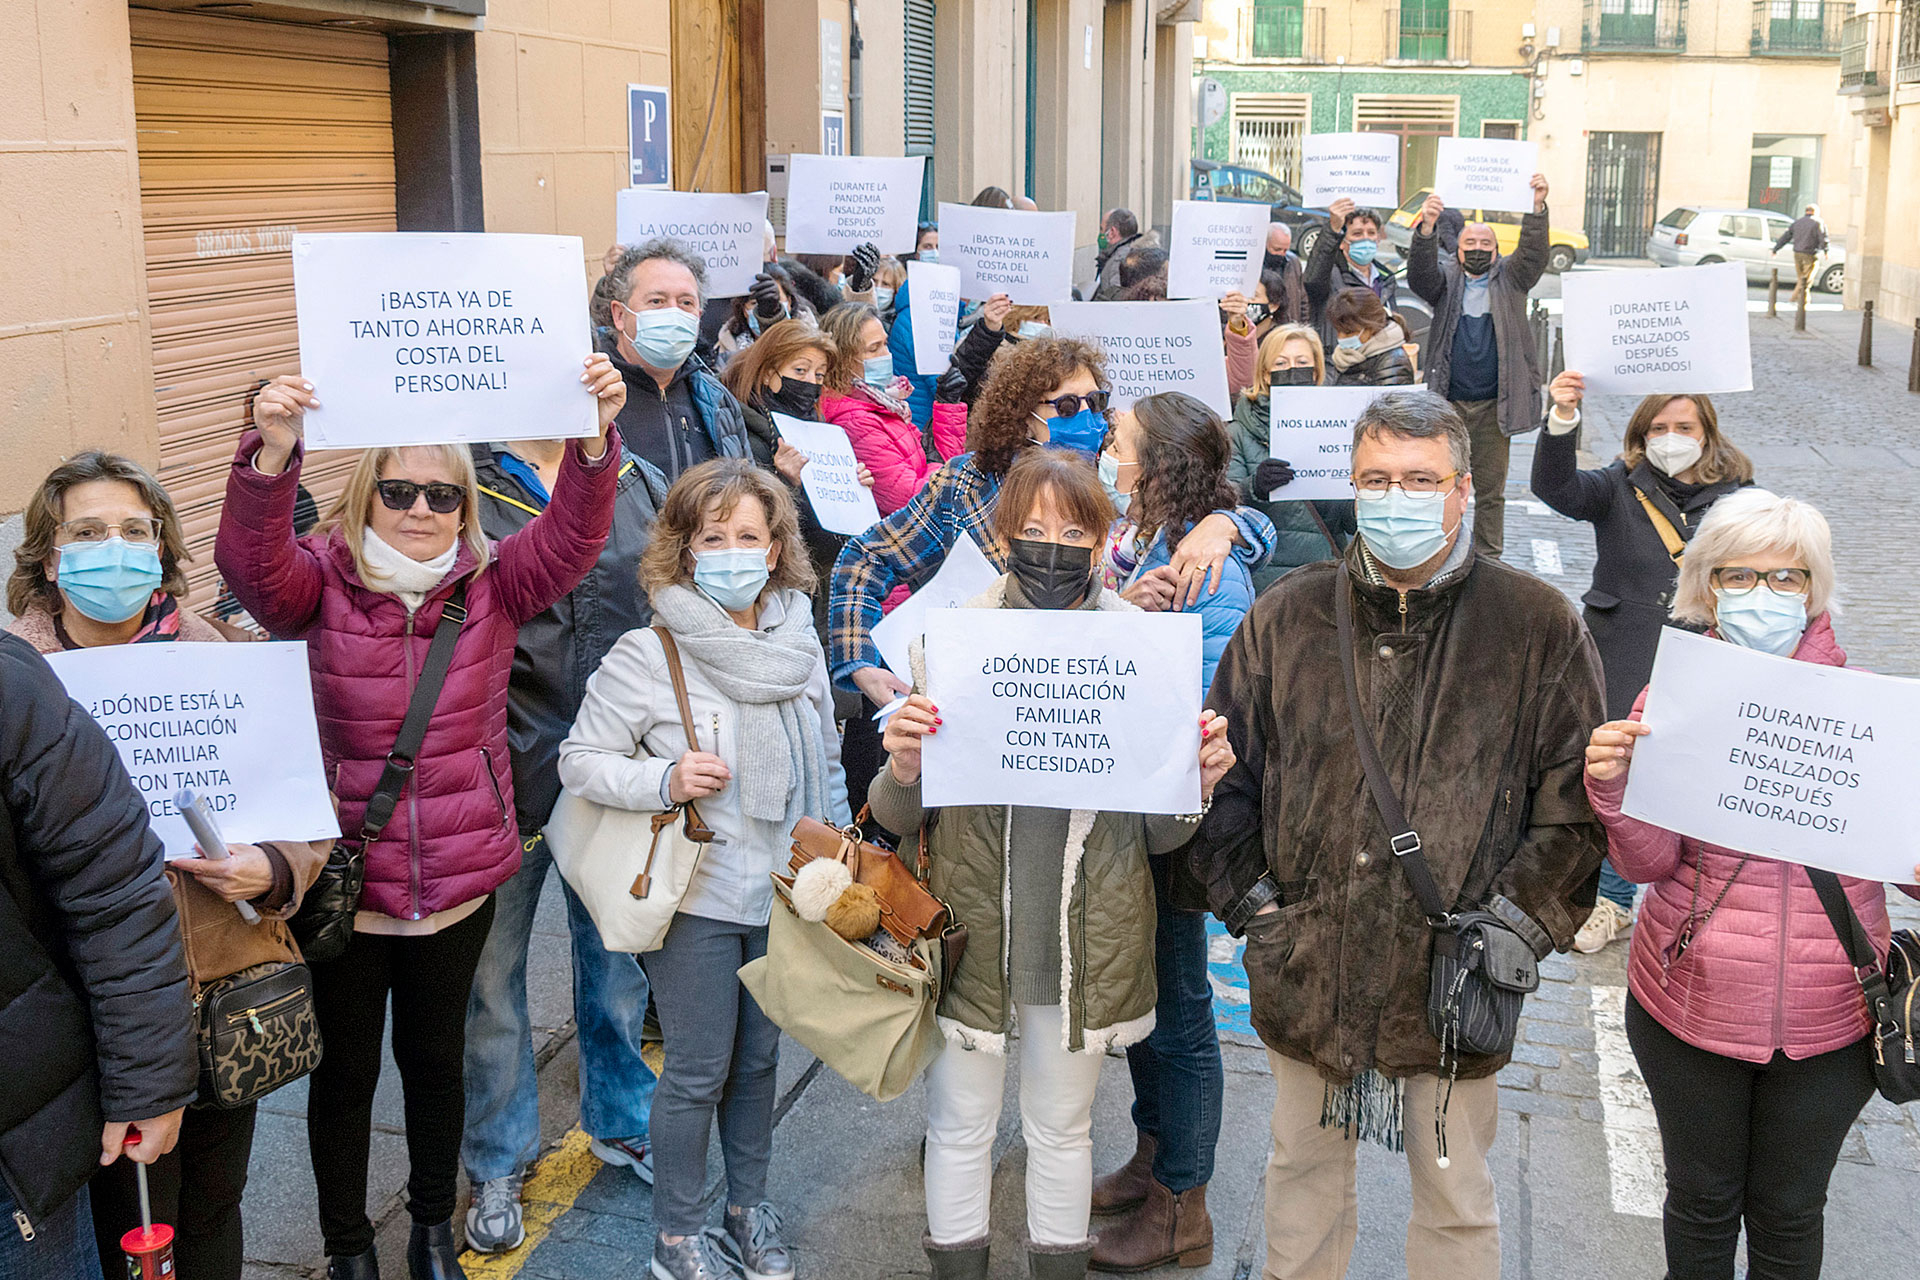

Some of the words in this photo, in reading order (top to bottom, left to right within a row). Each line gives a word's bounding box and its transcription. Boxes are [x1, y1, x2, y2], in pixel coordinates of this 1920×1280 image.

[643, 99, 656, 142] P
[830, 182, 875, 191] ¡DURANTE
[877, 182, 888, 191] LA
[835, 194, 881, 203] PANDEMIA
[829, 205, 885, 215] ENSALZADOS
[640, 223, 656, 236] LA
[659, 220, 729, 236] VOCACIÓN
[734, 221, 753, 234] NO
[837, 217, 876, 227] DESPUÉS
[1208, 224, 1243, 235] GERENCIA
[827, 228, 884, 238] IGNORADOS!
[972, 234, 1006, 245] ¡BASTA
[1008, 237, 1020, 247] YA
[1022, 238, 1035, 247] DE
[722, 239, 737, 252] LA
[1192, 236, 1234, 247] SERVICIOS
[959, 244, 990, 257] TANTO
[992, 249, 1040, 259] AHORRAR
[1042, 250, 1049, 260] A
[977, 260, 1008, 271] COSTA
[1010, 262, 1029, 272] DEL
[1207, 263, 1240, 273] AHORRO
[976, 271, 1029, 284] PERSONAL!
[381, 291, 452, 312] ¡BASTA
[457, 290, 482, 308] YA
[488, 290, 513, 308] DE
[1609, 301, 1671, 316] ¡DURANTE
[1674, 300, 1690, 311] LA
[349, 319, 420, 339] TANTO
[426, 317, 525, 337] AHORRAR
[530, 317, 545, 335] A
[1617, 316, 1682, 329] PANDEMIA
[1095, 336, 1132, 348] TRATO
[1135, 336, 1162, 349] QUE
[1165, 335, 1193, 348] NOS
[1612, 330, 1690, 345] ENSALZADOS
[395, 346, 462, 366] COSTA
[468, 345, 505, 364] DEL
[1122, 353, 1141, 365] NO
[1144, 353, 1158, 365] ES
[1161, 352, 1176, 365] EL
[1625, 345, 1679, 360] DESPUÉS
[1119, 369, 1145, 382] QUE
[1148, 368, 1196, 381] HEMOS
[1614, 360, 1692, 375] IGNORADOS!
[395, 371, 508, 394] PERSONAL!
[1276, 419, 1303, 429] ¡NOS
[1305, 419, 1348, 429] LLAMAN
[1318, 444, 1340, 453] NOS
[982, 653, 1060, 675] ¿DÓNDE
[1066, 655, 1110, 676] ESTÁ
[1115, 659, 1138, 676] LA
[992, 680, 1126, 701] CONCILIACIÓN
[90, 693, 175, 719] ¿DÓNDE
[180, 689, 220, 711] ESTÁ
[223, 693, 245, 710] LA
[1015, 706, 1102, 725] FAMILIAR
[1737, 701, 1847, 737] ¡DURANTE
[1850, 723, 1876, 742] LA
[104, 714, 238, 742] CONCILIACIÓN
[1006, 730, 1046, 747] CON
[1051, 732, 1111, 750] TANTA
[1745, 727, 1855, 764] PANDEMIA
[133, 744, 220, 766] FAMILIAR
[1001, 753, 1116, 774] NECESIDAD?
[1728, 747, 1862, 789] ENSALZADOS
[172, 769, 232, 789] TANTA
[1743, 775, 1834, 808] DESPUÉS
[1717, 792, 1848, 835] IGNORADOS!
